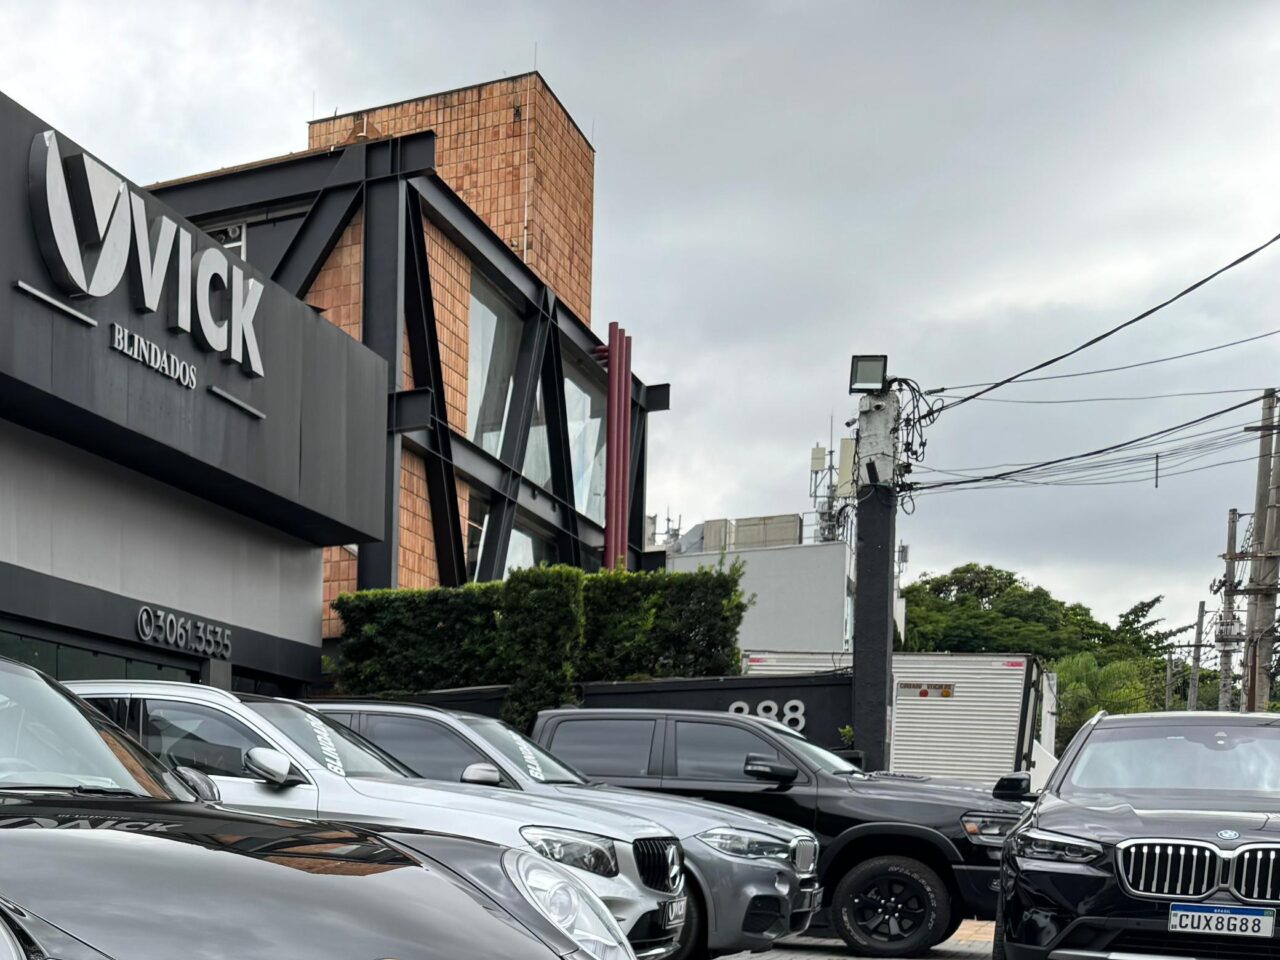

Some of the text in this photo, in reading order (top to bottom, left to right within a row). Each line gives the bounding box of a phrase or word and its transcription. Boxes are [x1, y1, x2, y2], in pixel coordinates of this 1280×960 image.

[129, 190, 265, 378] VICK
[112, 320, 198, 390] BLINDADOS
[154, 609, 232, 659] 3061.3535
[1178, 913, 1262, 933] CUX8G88
